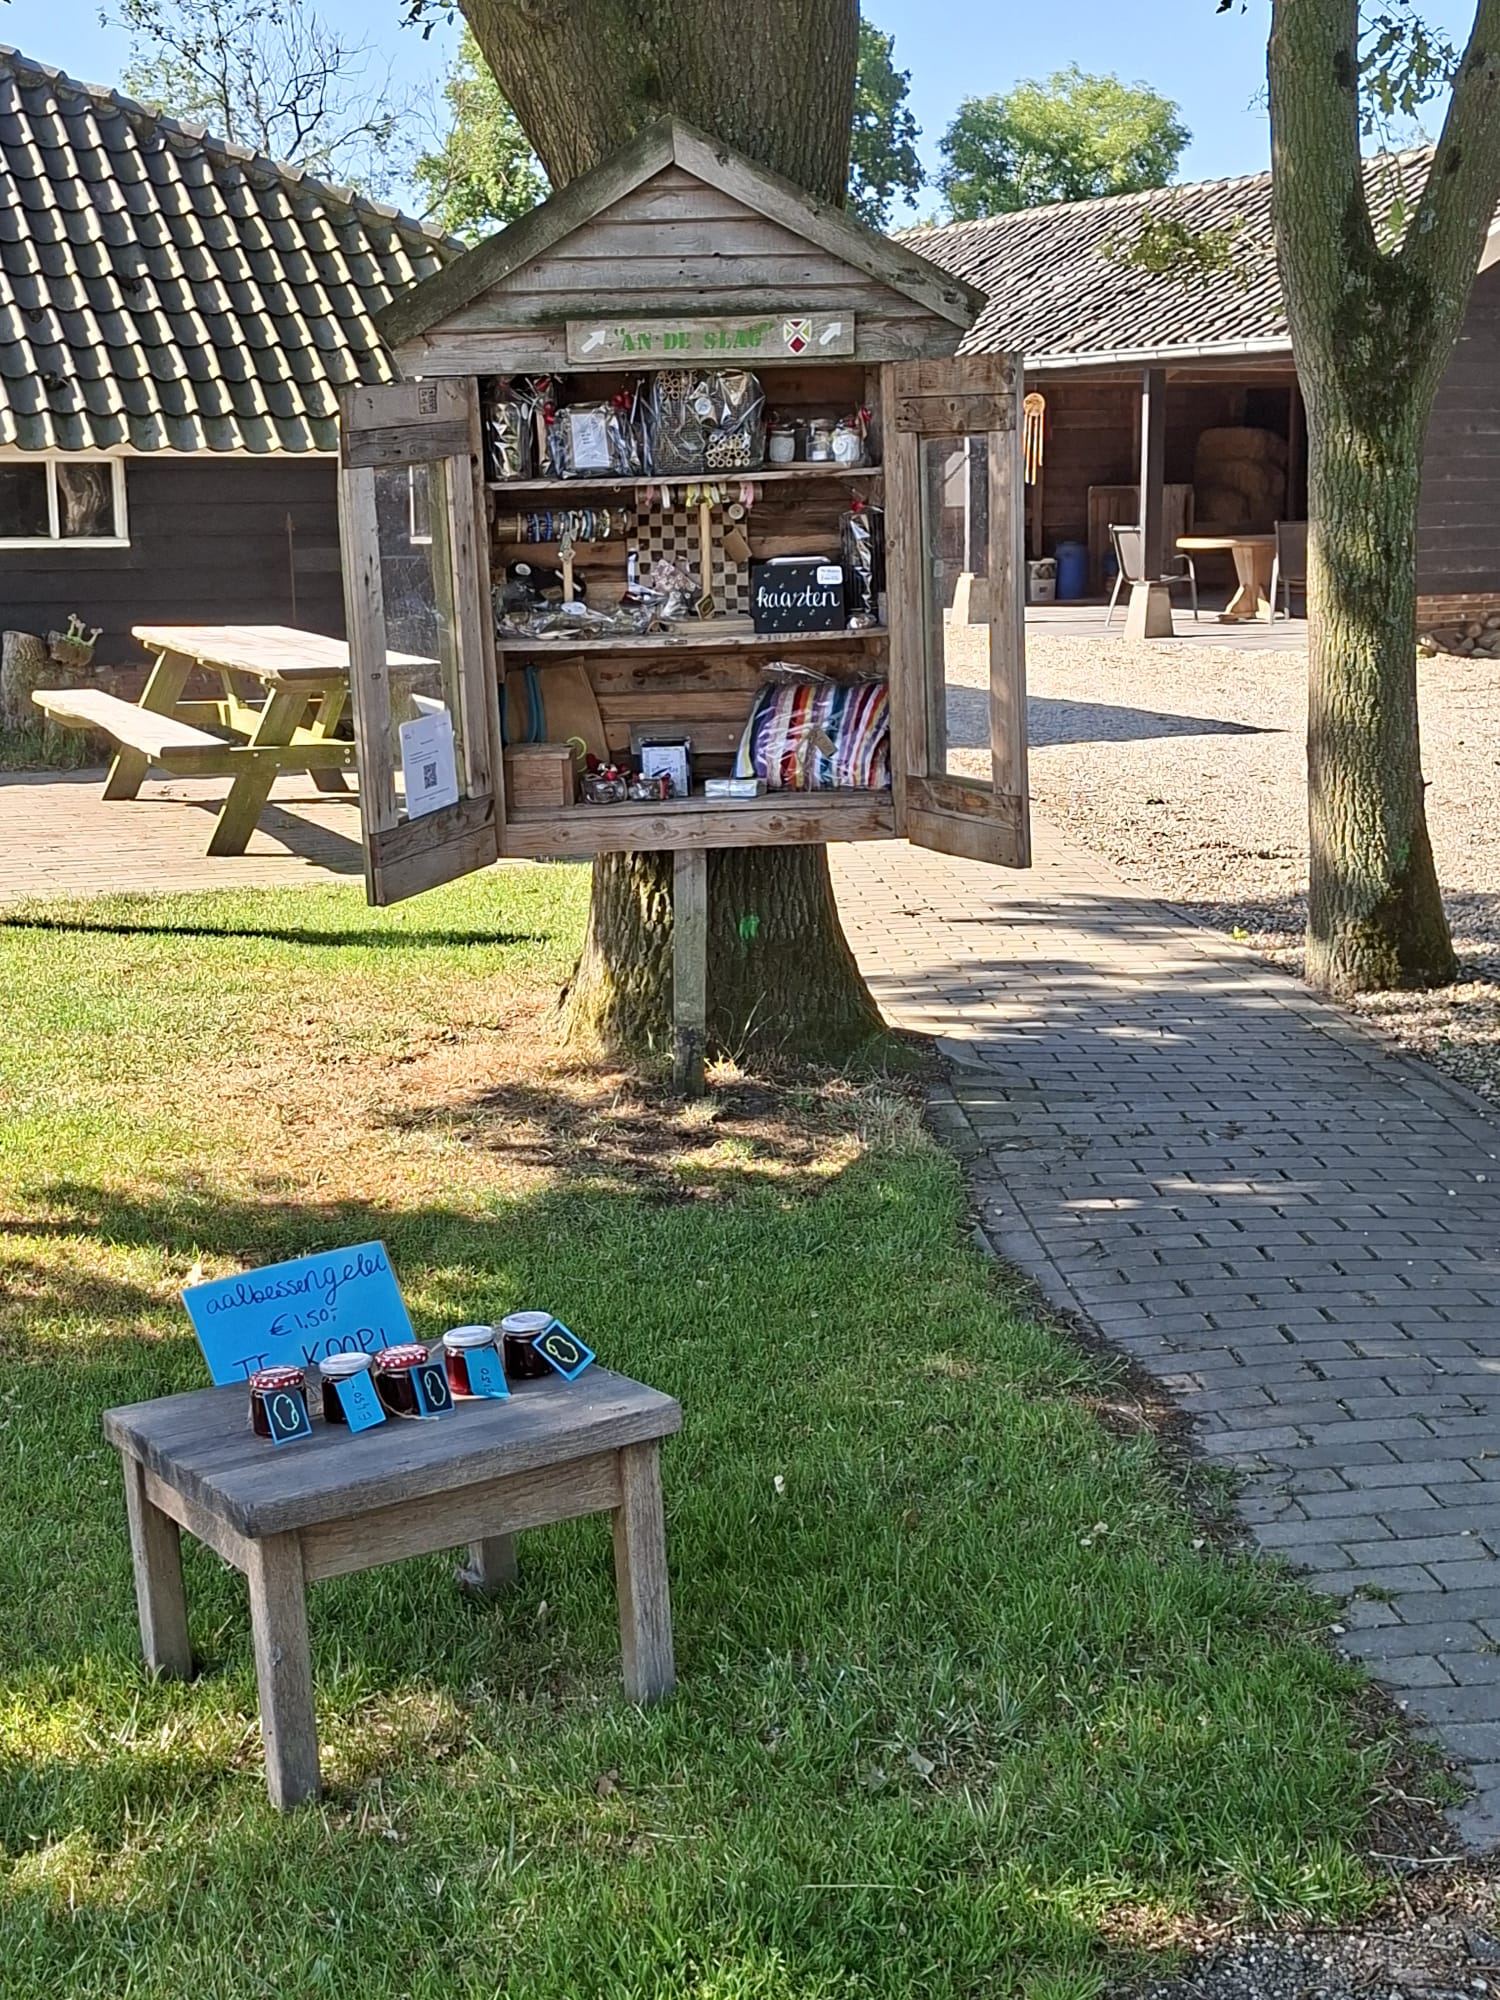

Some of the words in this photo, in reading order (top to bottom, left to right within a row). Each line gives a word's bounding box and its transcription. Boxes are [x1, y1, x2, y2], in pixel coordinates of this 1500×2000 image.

[663, 331, 692, 350] DE
[756, 584, 841, 608] kaarten
[206, 1252, 388, 1315] aalbessengelei
